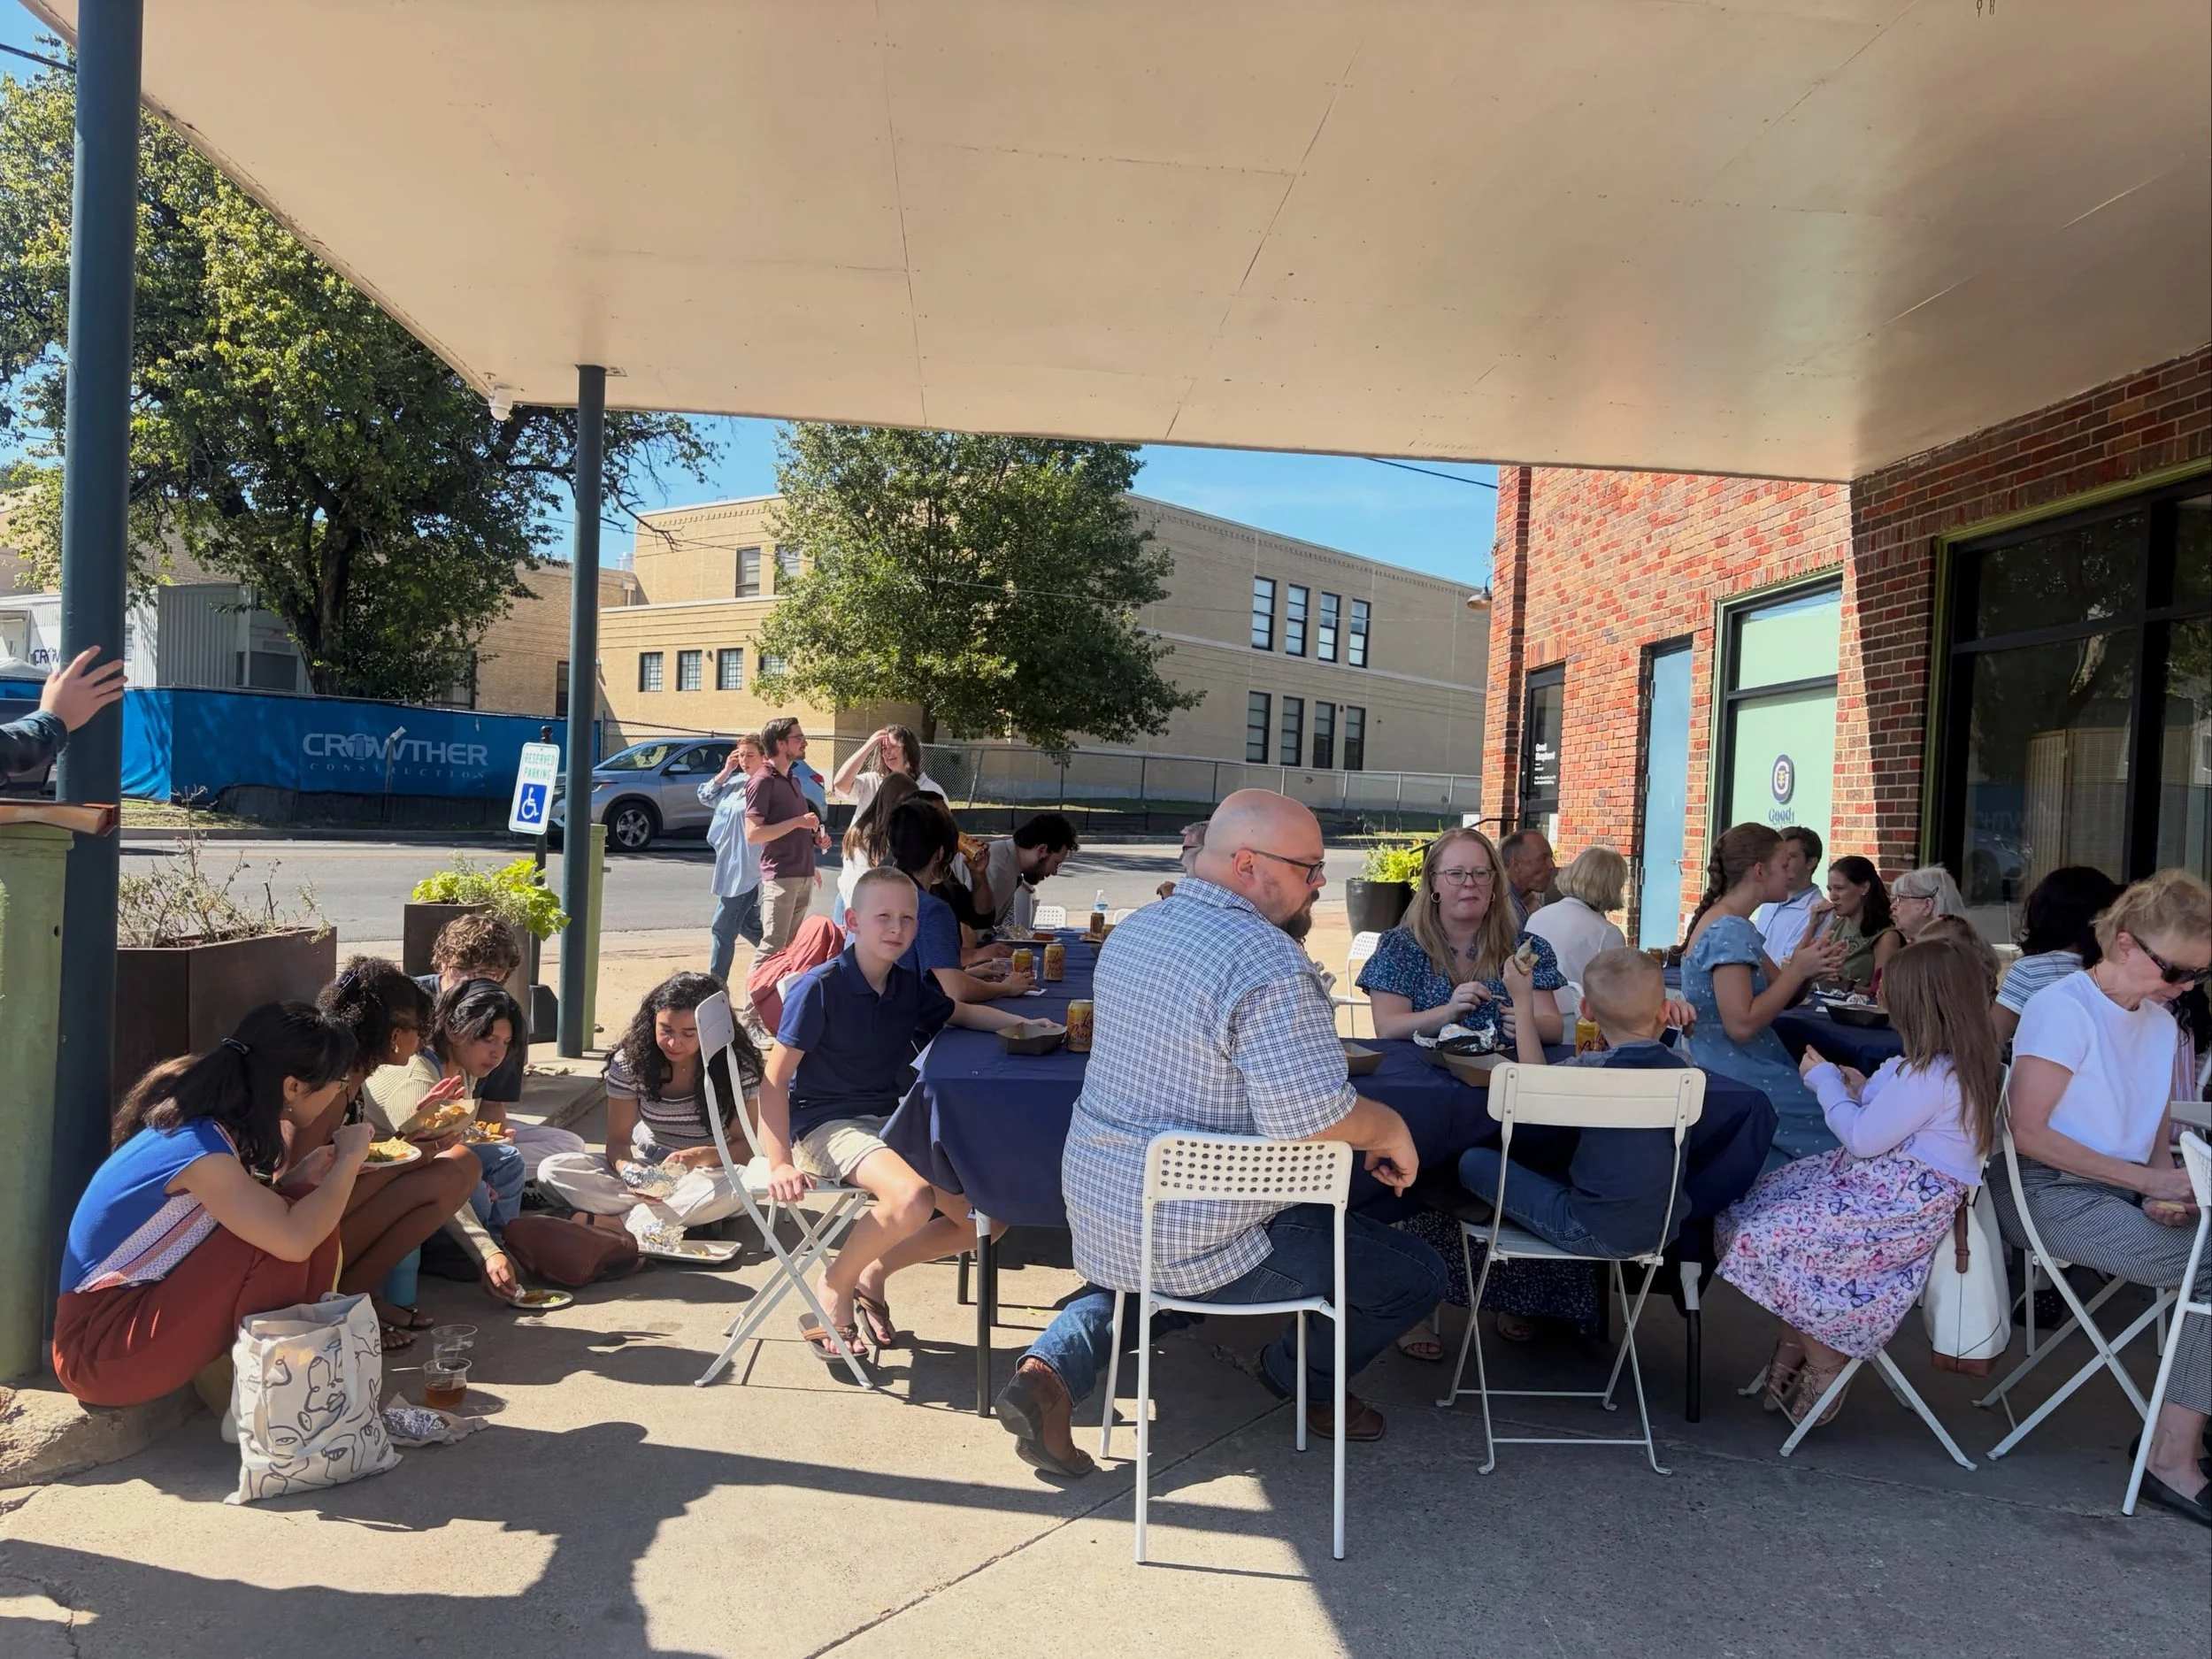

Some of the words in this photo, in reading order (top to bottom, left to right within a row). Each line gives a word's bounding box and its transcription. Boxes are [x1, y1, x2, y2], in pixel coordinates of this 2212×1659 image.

[303, 733, 488, 766] CROWTHER
[523, 753, 556, 766] RESERVED
[523, 766, 552, 780] PARKING
[1769, 807, 1793, 824] Good
